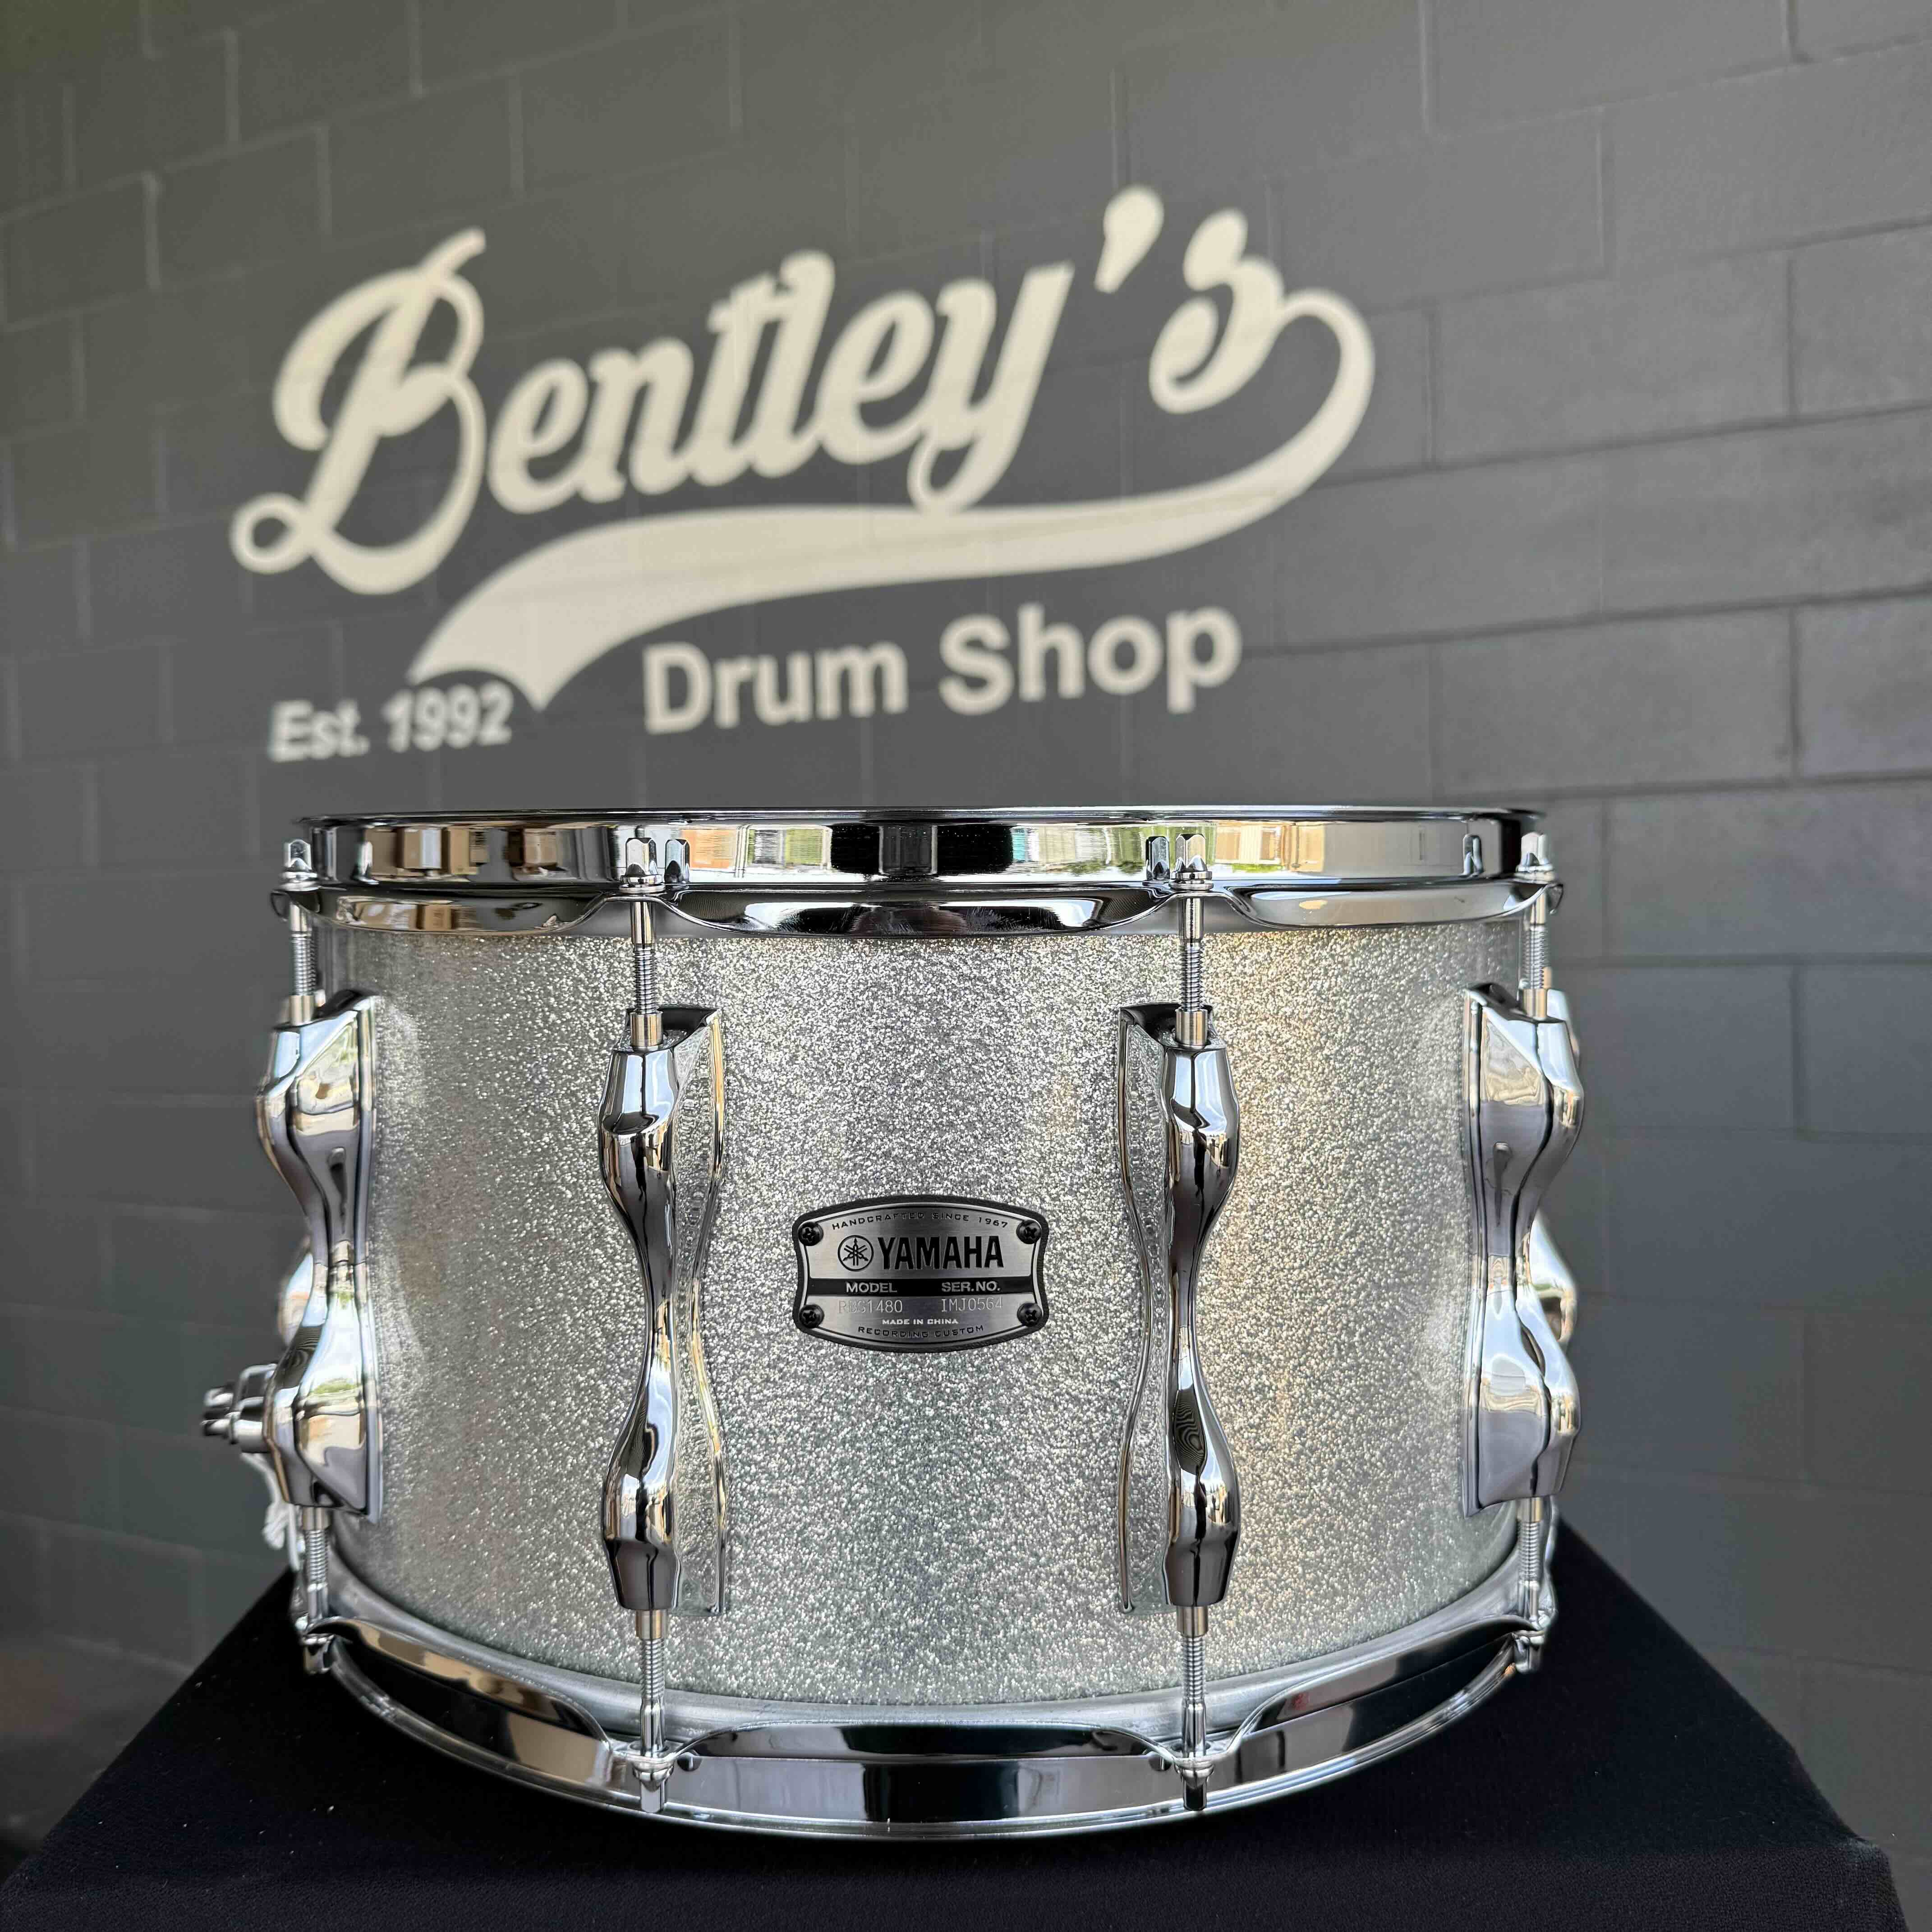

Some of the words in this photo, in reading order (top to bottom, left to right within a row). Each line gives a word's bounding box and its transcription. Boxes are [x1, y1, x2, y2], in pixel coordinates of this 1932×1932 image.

[232, 186, 1375, 594] Bentley's
[645, 644, 906, 732] Drum
[941, 605, 1240, 712] Shop
[271, 701, 368, 761] Est.
[386, 684, 512, 750] 1992
[832, 1212, 924, 1230] HANDCRAFTED
[932, 1212, 969, 1222] SINCE
[979, 1217, 1008, 1228] 1967
[877, 1236, 1004, 1270] YAMAHA
[846, 1282, 897, 1293] MODEL
[838, 1299, 902, 1313] RBS1480
[858, 1326, 929, 1338] RECORDING
[934, 1324, 984, 1337] CUSTOM
